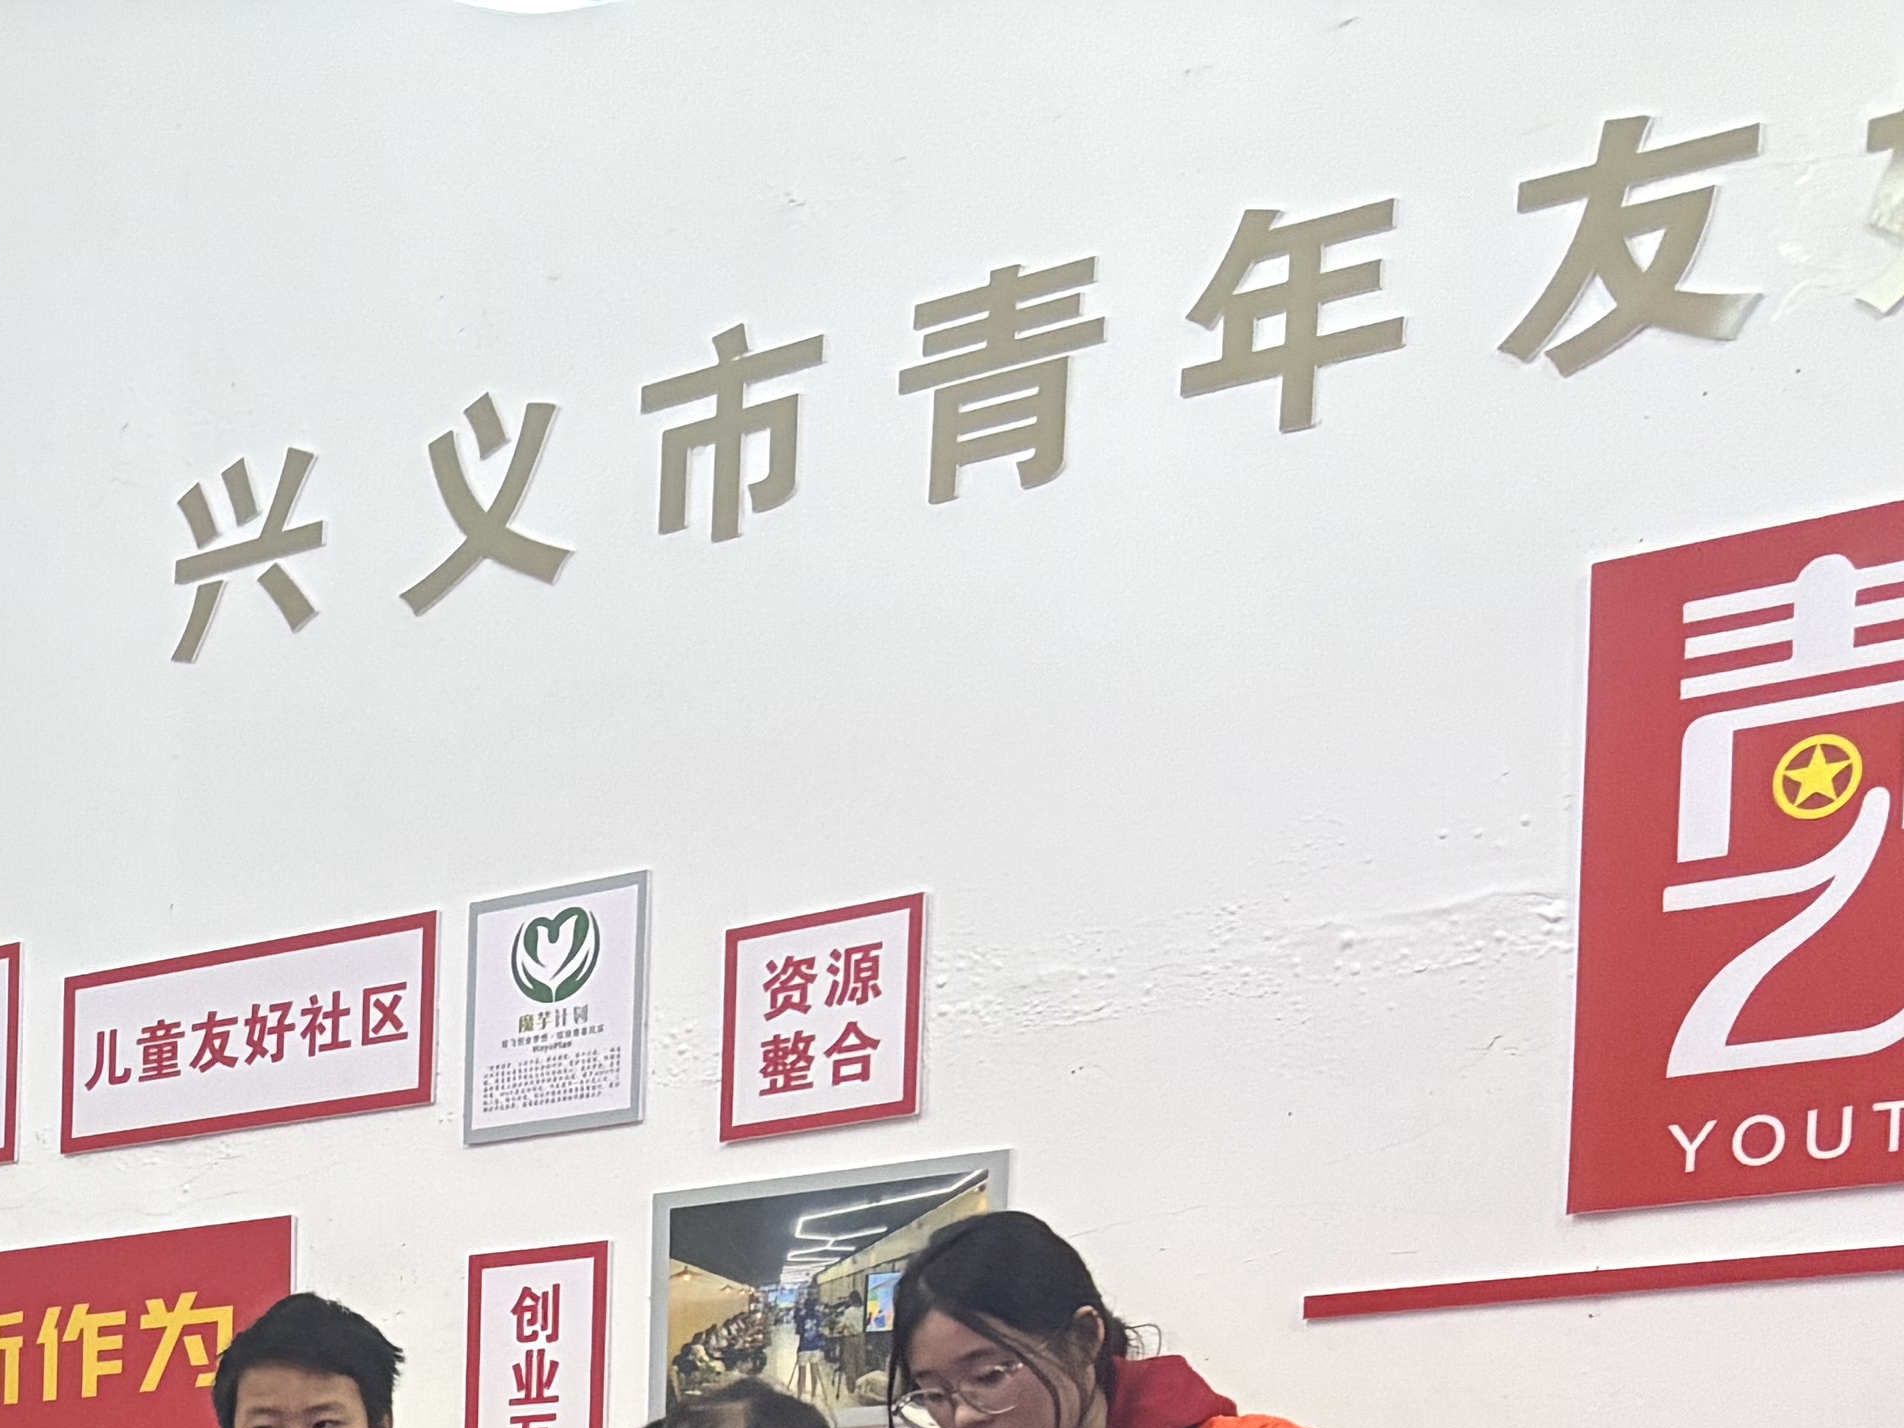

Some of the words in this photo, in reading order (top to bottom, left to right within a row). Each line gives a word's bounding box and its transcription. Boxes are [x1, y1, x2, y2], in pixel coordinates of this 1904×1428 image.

[172, 110, 1904, 662] 兴义市青年友
[762, 940, 884, 1022] 资源
[84, 981, 409, 1092] 儿童友好社区
[759, 1020, 882, 1097] 整合
[1667, 1100, 1904, 1174] YOUT
